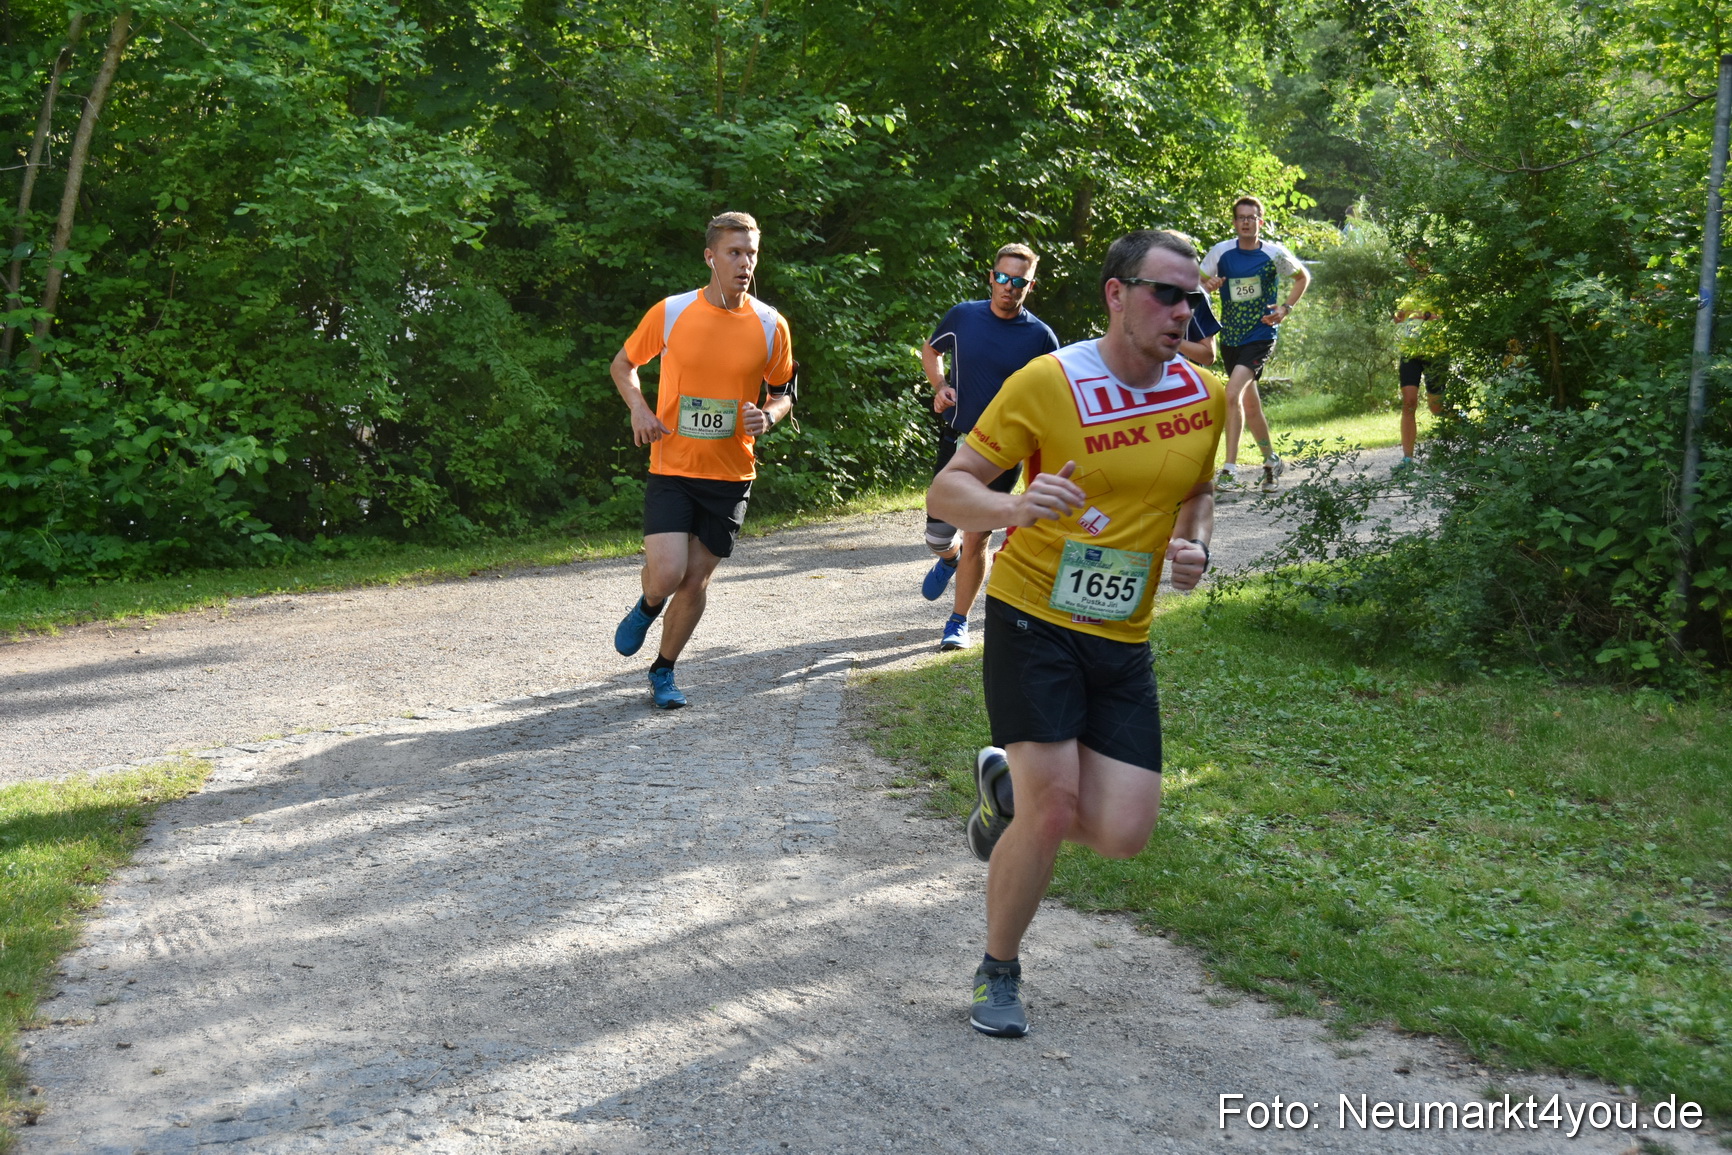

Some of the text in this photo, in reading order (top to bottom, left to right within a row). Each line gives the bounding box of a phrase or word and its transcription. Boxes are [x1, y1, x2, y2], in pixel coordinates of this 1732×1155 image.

[1236, 285, 1255, 296] 256
[691, 412, 723, 429] 108
[1084, 410, 1213, 454] MAX BÖGL
[973, 427, 1001, 452] oegl.de
[1070, 569, 1137, 602] 1655
